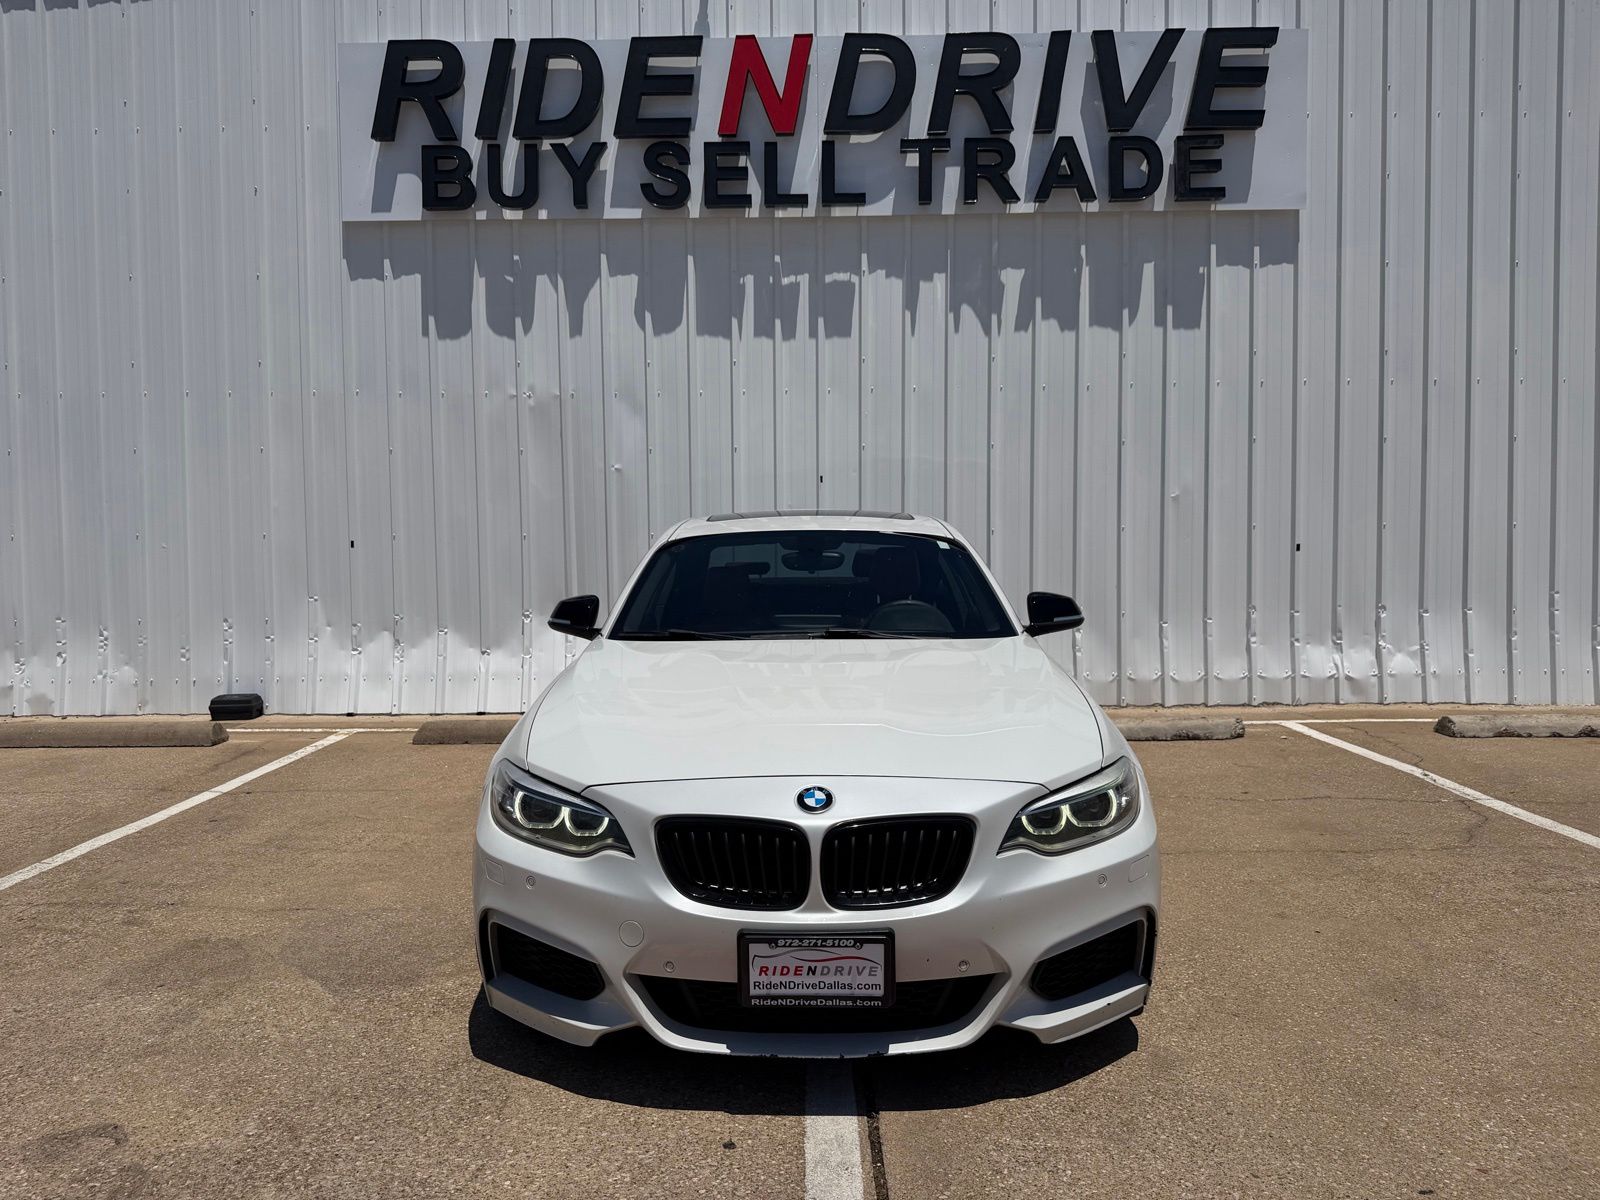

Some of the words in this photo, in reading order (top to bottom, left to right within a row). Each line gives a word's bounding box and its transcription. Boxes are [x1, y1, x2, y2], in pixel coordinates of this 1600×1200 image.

[371, 27, 1279, 141] RIDENDRIVE
[421, 142, 606, 211] BUY
[640, 138, 866, 209] SELL
[899, 133, 1226, 205] TRADE
[777, 939, 854, 947] 972-271-5100
[758, 965, 878, 976] RIDENDRIVE
[753, 980, 881, 990] RideNDriveDallas.com
[751, 998, 882, 1006] RideNDriveDallas.com
